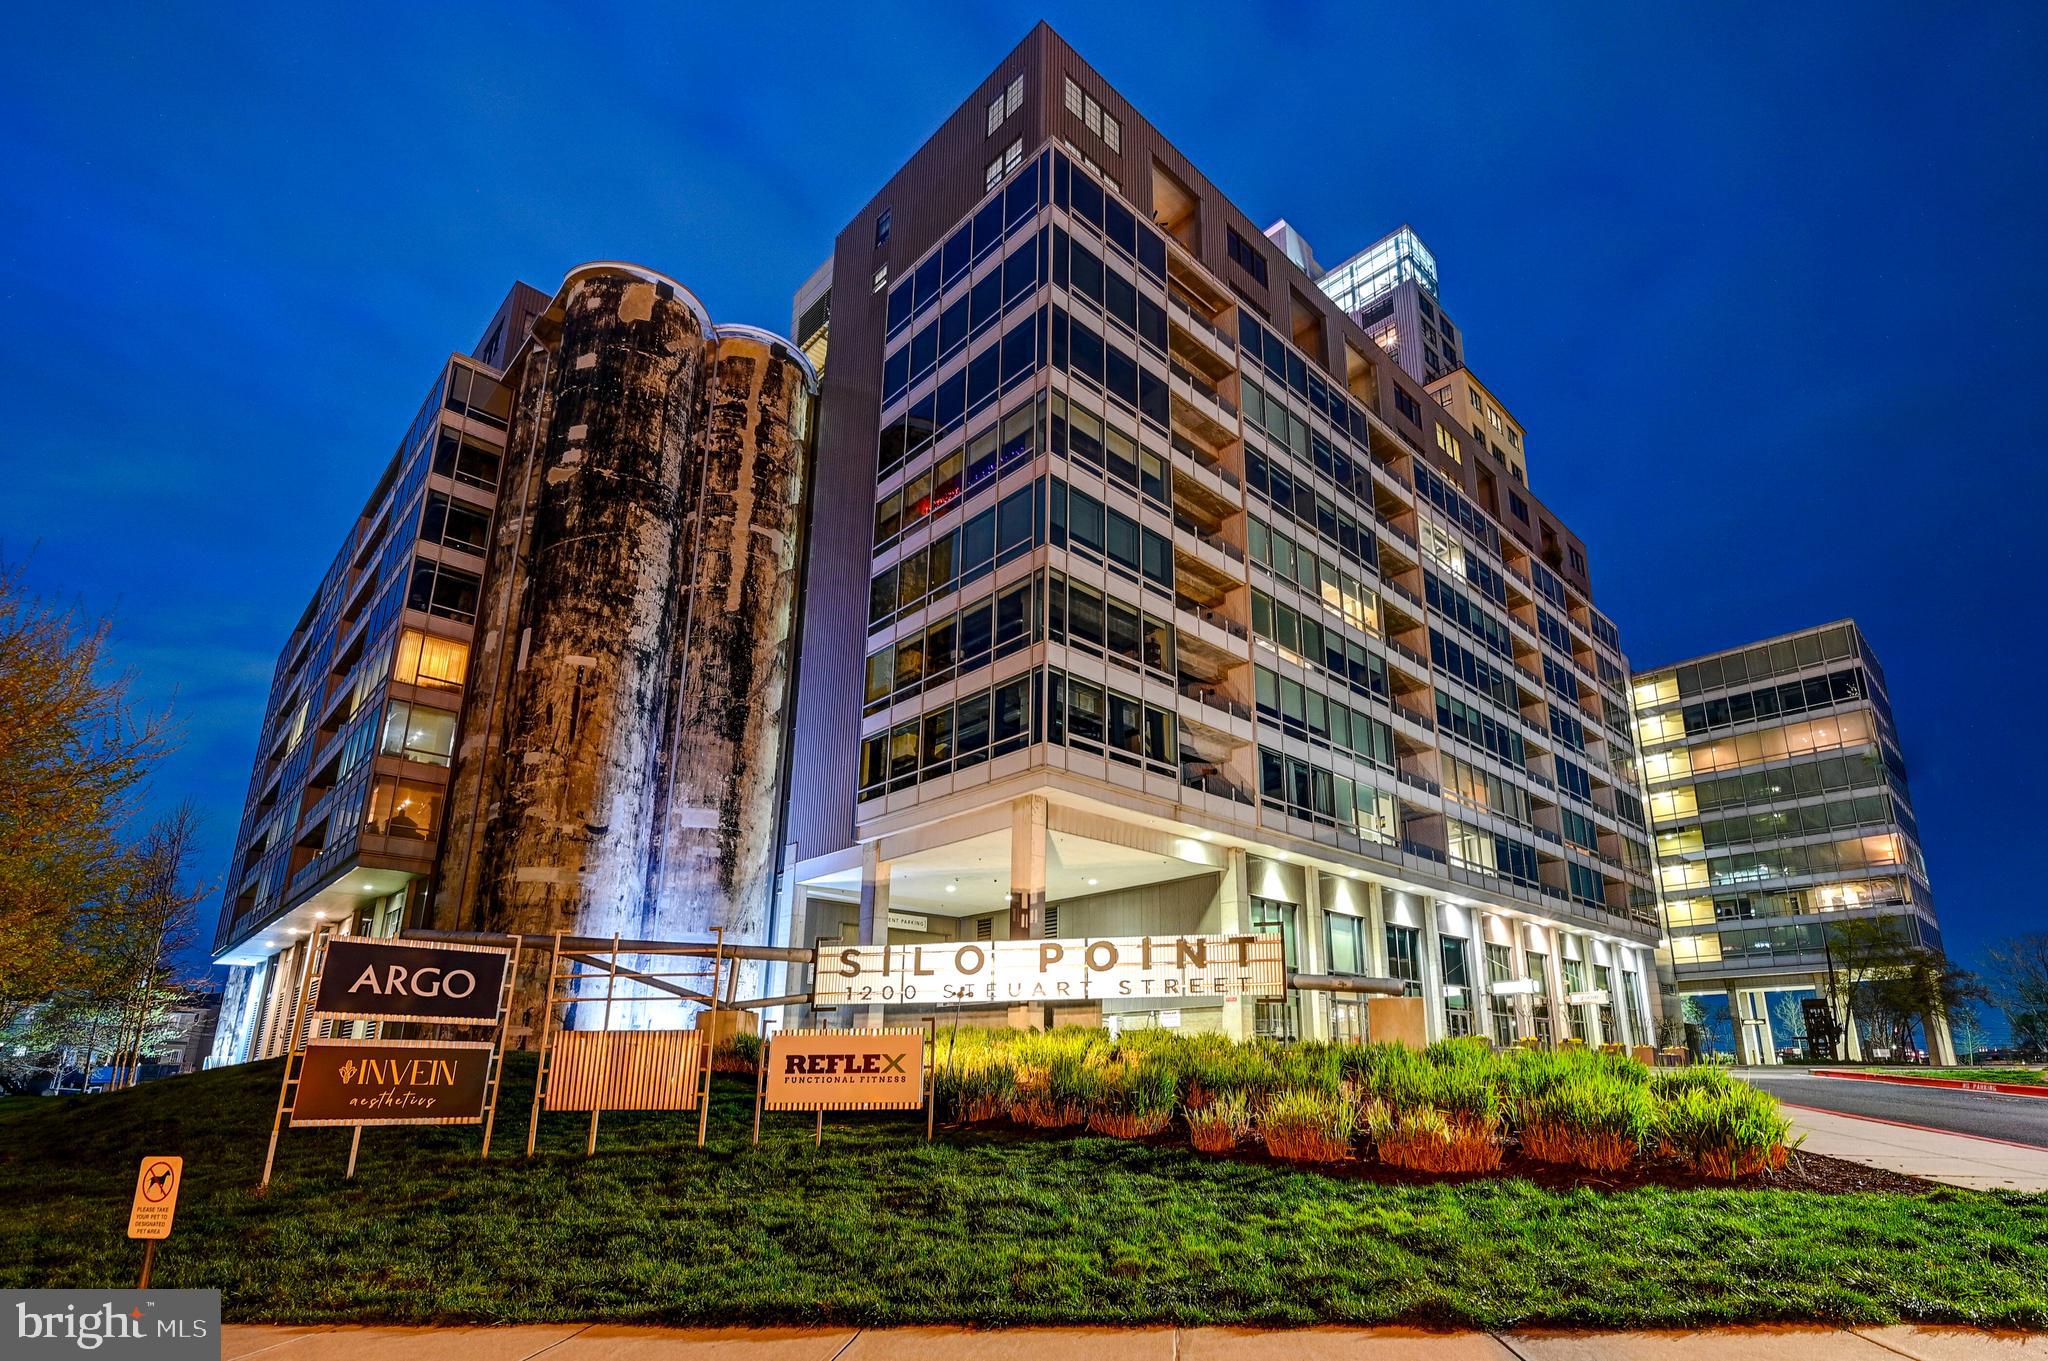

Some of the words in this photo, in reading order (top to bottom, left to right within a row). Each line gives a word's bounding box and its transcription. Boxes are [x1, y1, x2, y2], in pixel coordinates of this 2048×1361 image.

[839, 945, 985, 978] SILO
[1039, 935, 1255, 973] POINT
[347, 963, 476, 999] ARGO
[846, 985, 917, 1001] 1200
[943, 980, 1092, 999] STEUART
[1118, 976, 1253, 996] STREET
[357, 1059, 458, 1086] INVEIN
[784, 1053, 907, 1075] REFLEX
[784, 1075, 855, 1084] FUNCTIONAL
[860, 1075, 906, 1084] FITNESS
[349, 1087, 437, 1110] aesthetics
